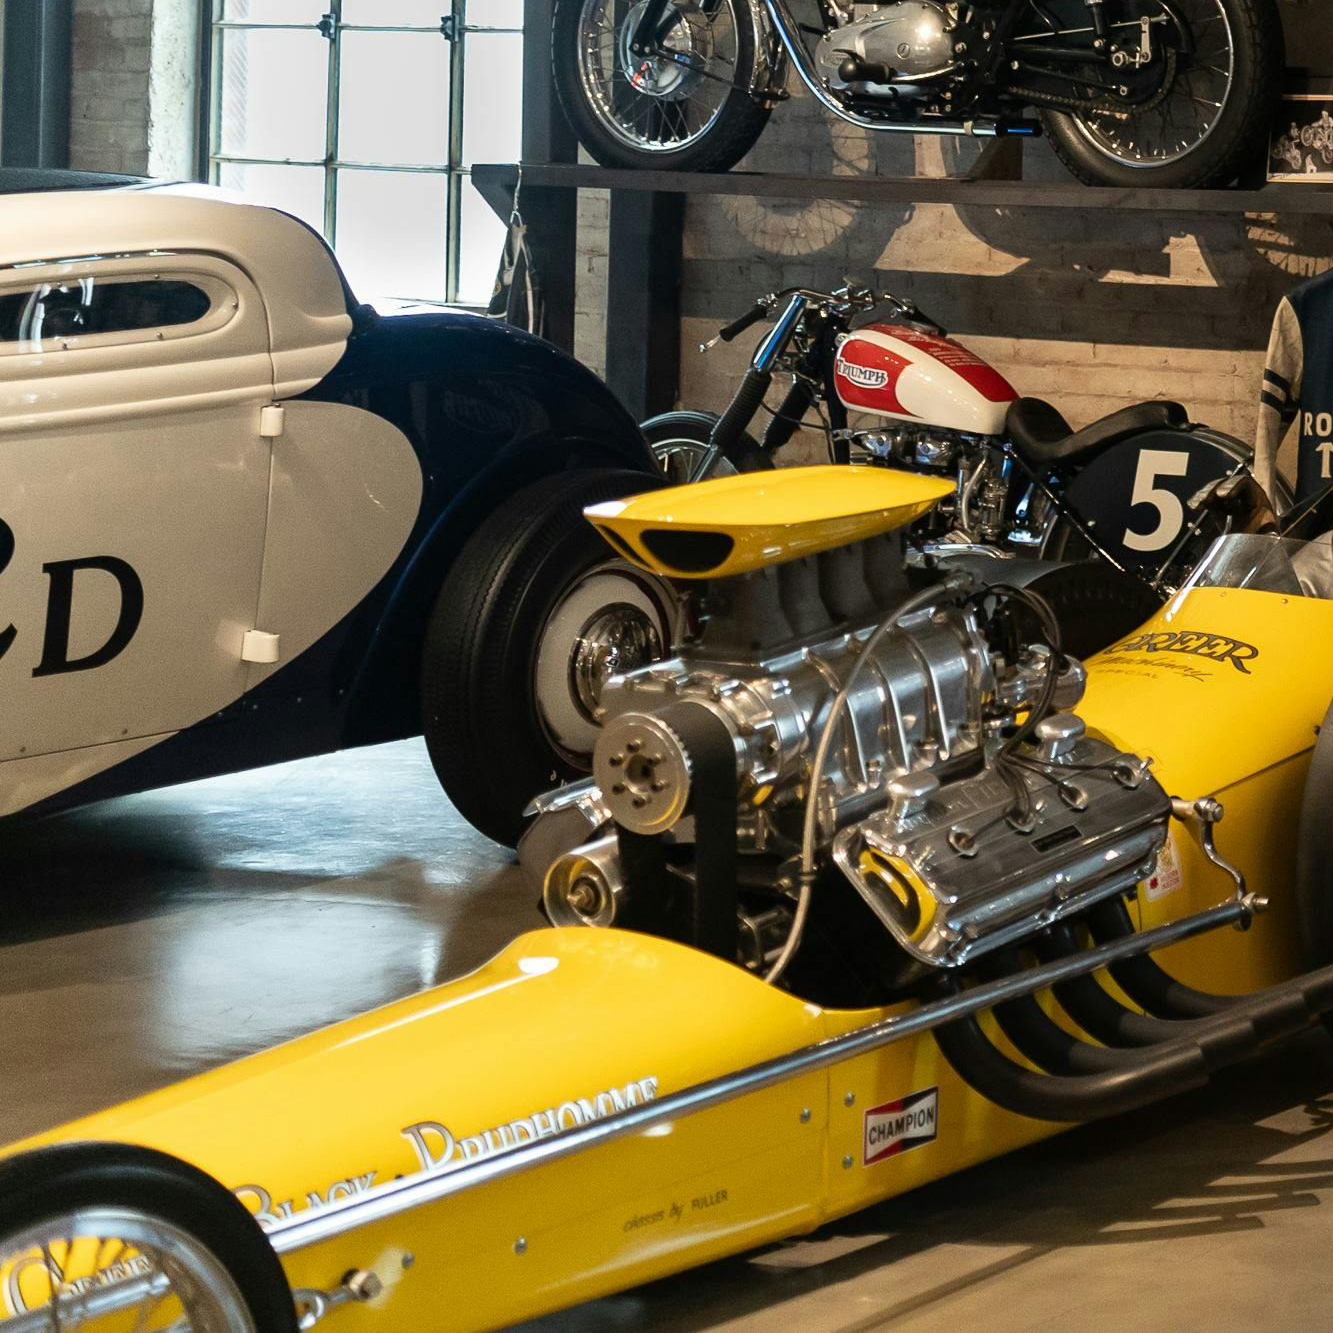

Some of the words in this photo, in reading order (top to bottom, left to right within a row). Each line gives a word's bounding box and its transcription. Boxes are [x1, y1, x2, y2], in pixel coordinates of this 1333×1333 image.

[836, 357, 887, 388] TRIUMPH
[1122, 448, 1190, 552] 5
[0, 517, 145, 679] D
[1102, 630, 1260, 676] GREER
[867, 1106, 936, 1147] CHAMPION
[691, 1189, 729, 1211] FULLER
